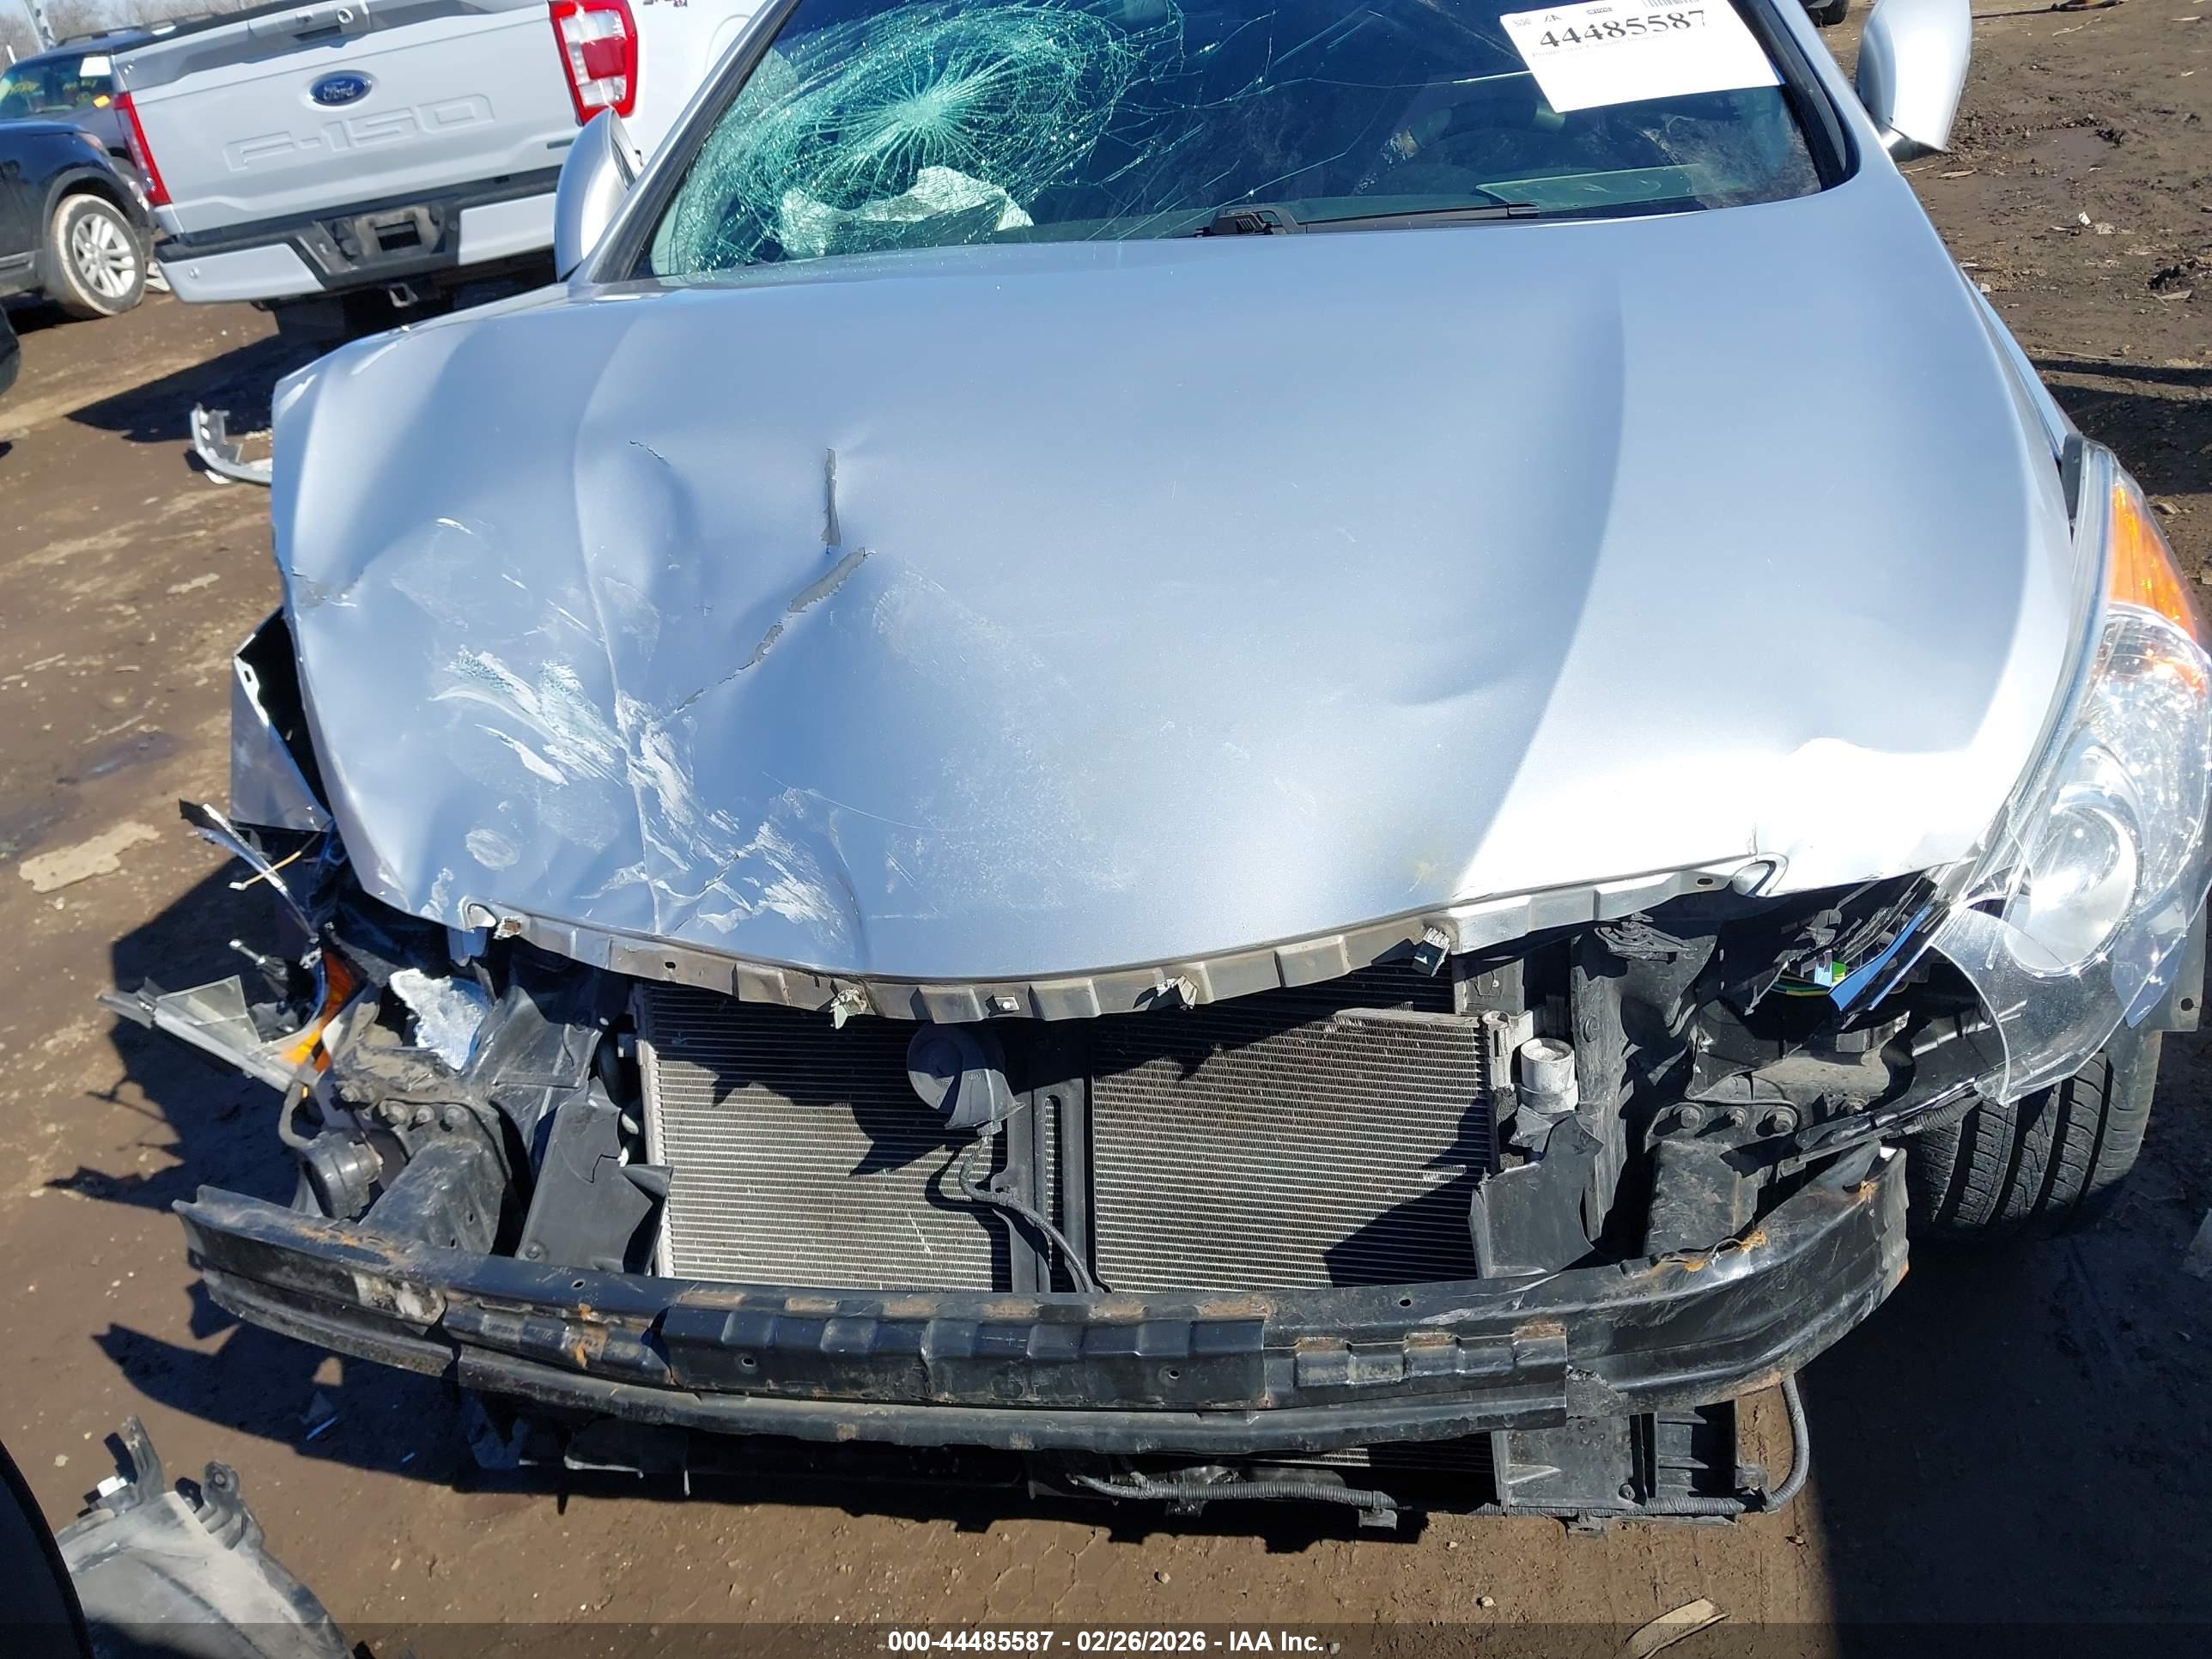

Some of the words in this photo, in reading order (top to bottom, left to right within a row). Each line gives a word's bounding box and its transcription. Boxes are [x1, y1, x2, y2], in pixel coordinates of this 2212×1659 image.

[1540, 9, 1705, 47] 44485587
[322, 81, 356, 100] Ford
[222, 93, 495, 173] F-150
